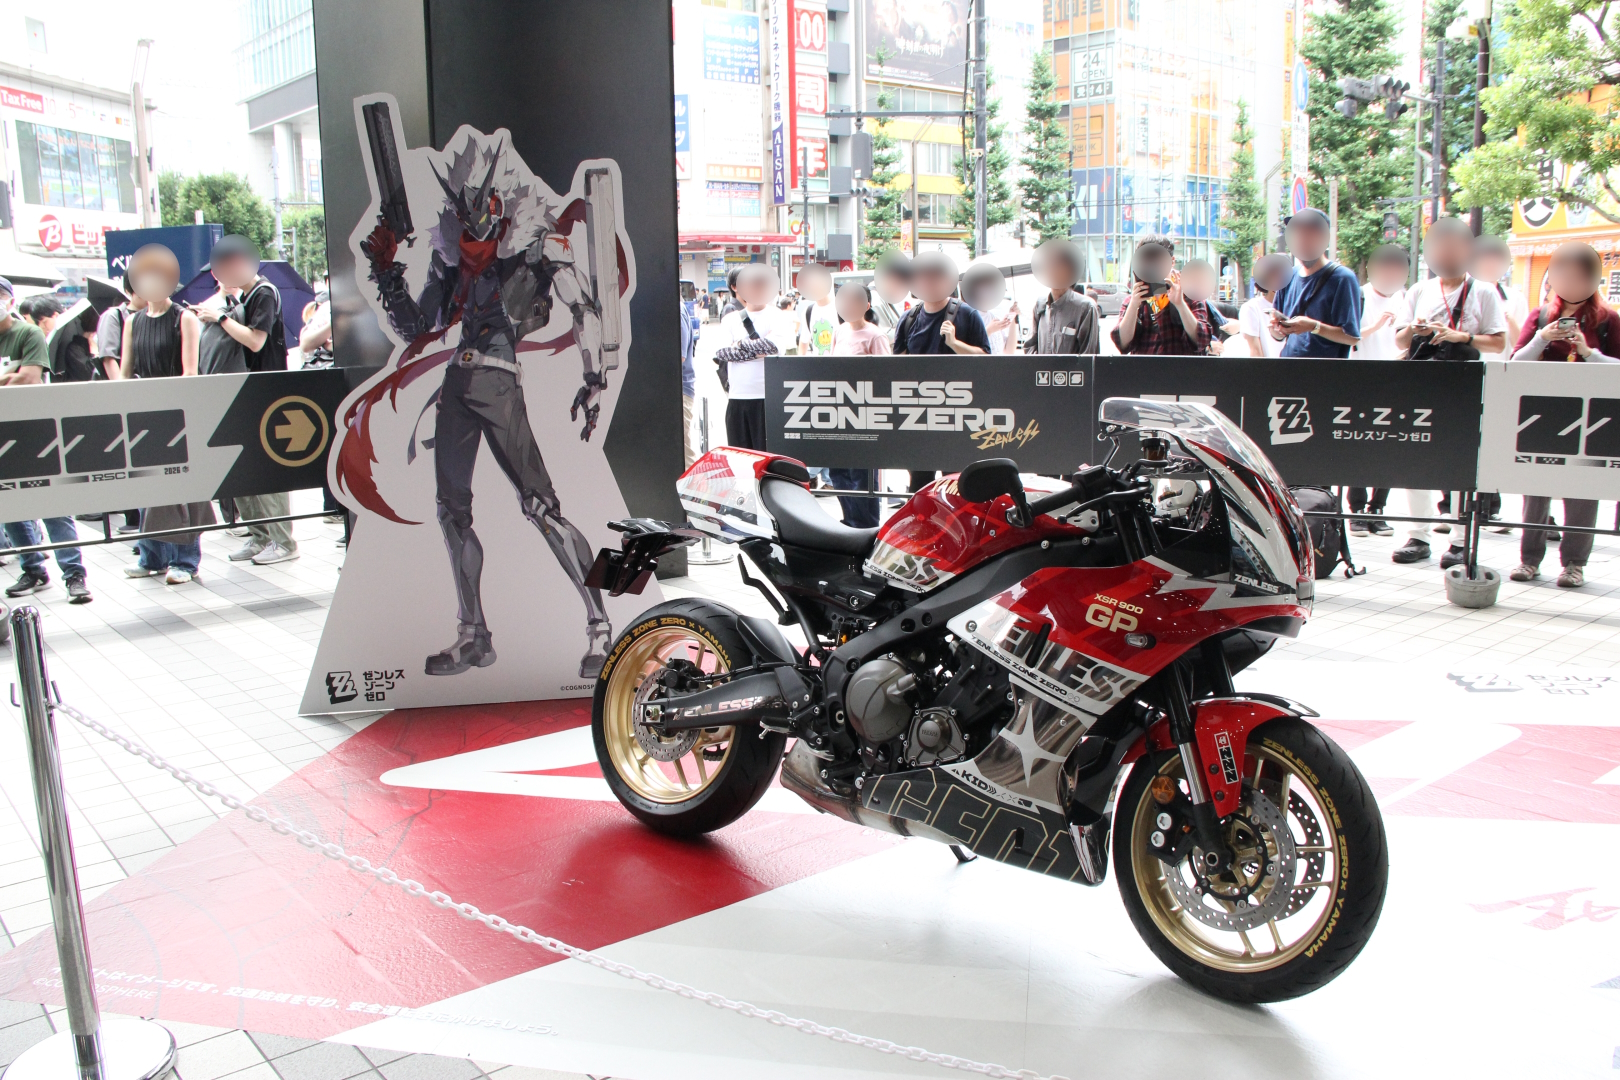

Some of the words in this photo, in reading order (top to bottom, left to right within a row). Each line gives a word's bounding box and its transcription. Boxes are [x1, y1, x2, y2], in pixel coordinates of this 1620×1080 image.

[772, 0, 781, 122] ーブル・ネットワーク機器
[1082, 69, 1105, 79] OPEN
[0, 89, 20, 106] Tax
[20, 94, 43, 111] Free
[774, 131, 783, 197] AISAN
[783, 381, 973, 405] ZENLESS
[784, 406, 893, 429] ZONE
[898, 407, 1015, 432] ZERO
[1332, 430, 1432, 442] ゼンレスゾーンゼロ
[92, 471, 126, 482] RSC
[931, 478, 961, 496] YAM
[1235, 574, 1279, 593] ZENLESS
[1093, 593, 1118, 607] XSR
[1118, 600, 1144, 615] 900
[1085, 603, 1139, 633] GP
[600, 635, 632, 681] ZENLESS
[633, 619, 659, 637] ZONE
[660, 617, 686, 626] ZERO
[698, 625, 732, 669] YAMAHA
[363, 669, 405, 681] ゼンレス
[364, 681, 395, 691] ゾーン
[1012, 661, 1039, 681] ZONE
[1039, 677, 1068, 696] ZERO
[364, 691, 386, 702] ゼロ
[560, 683, 595, 692] ©COGNOSP
[1263, 737, 1320, 785] ZENLESS
[1319, 786, 1342, 829] ZONE
[1338, 834, 1349, 879] ZERO
[1305, 897, 1344, 958] YAMAHA
